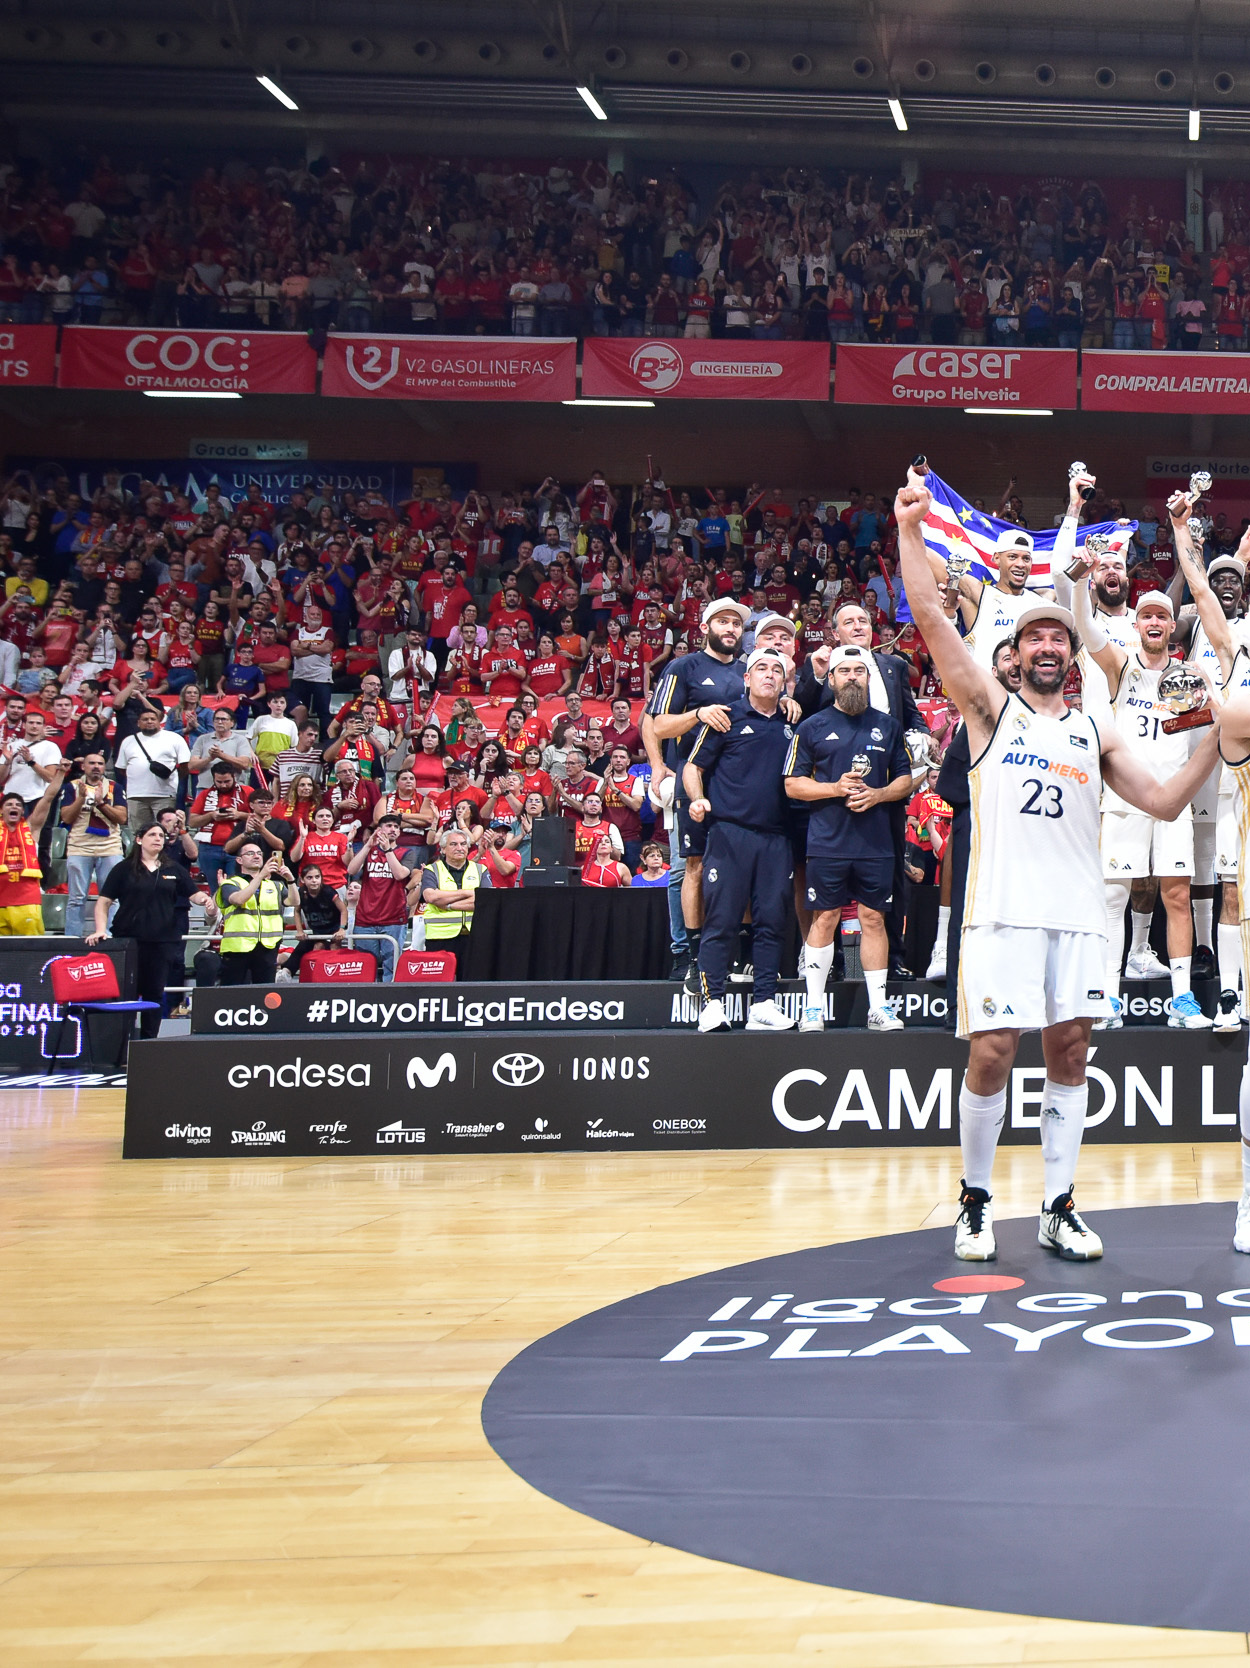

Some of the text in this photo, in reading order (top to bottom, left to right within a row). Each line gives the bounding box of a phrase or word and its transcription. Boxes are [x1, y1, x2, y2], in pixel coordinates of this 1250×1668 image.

[405, 358, 554, 375] V2 GASOLINERAS
[700, 361, 773, 376] INGENIERÍA
[918, 351, 1021, 380] caser
[124, 374, 249, 390] OFTALMOLOGÍA
[405, 378, 517, 388] El MVP del Combustible
[892, 385, 1020, 403] Grupo Helvetia
[195, 442, 249, 456] Grada
[1152, 461, 1250, 475] Grada Norte
[1136, 714, 1159, 740] 31
[1001, 752, 1089, 785] AUTOHERO
[1019, 778, 1064, 819] 23
[308, 844, 338, 853] UCAM
[83, 962, 104, 973] UCAM
[340, 961, 363, 969] UCAM
[214, 995, 624, 1026] acb #PlayoffLigaEndesa
[228, 1056, 371, 1089] endesa
[571, 1055, 651, 1082] IONOS
[165, 1123, 212, 1138] divina
[309, 1120, 347, 1134] renfe
[652, 1118, 707, 1130] ONEBOX
[231, 1130, 286, 1144] SPALDING
[376, 1131, 425, 1144] LOTUS
[586, 1128, 619, 1139] Halcón
[707, 1293, 989, 1324] liga
